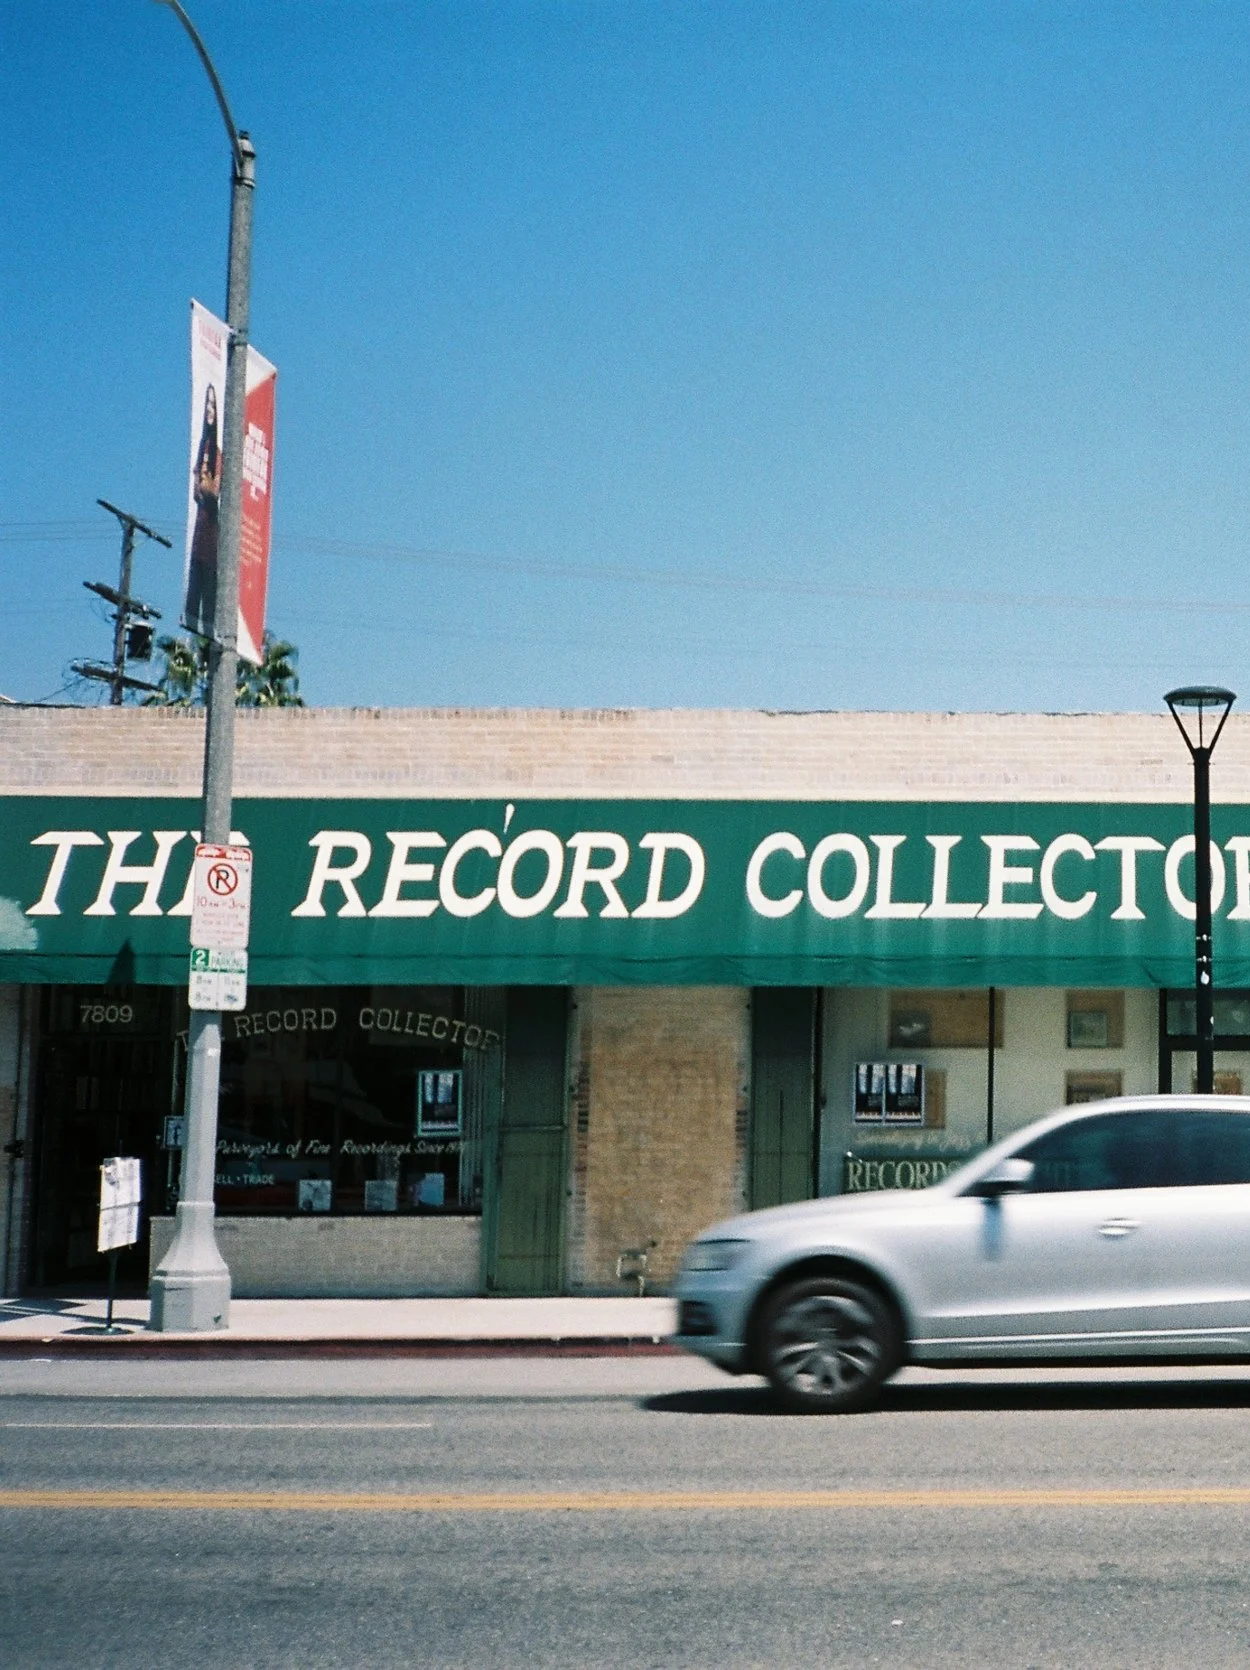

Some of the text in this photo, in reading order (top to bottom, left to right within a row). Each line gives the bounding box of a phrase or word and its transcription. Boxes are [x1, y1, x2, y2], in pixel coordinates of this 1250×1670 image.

[290, 829, 705, 918] RECORD
[195, 950, 206, 966] 2
[80, 1004, 133, 1024] 7809
[234, 1008, 337, 1038] RECORD
[286, 1138, 301, 1158] of
[243, 1173, 275, 1185] TRADE
